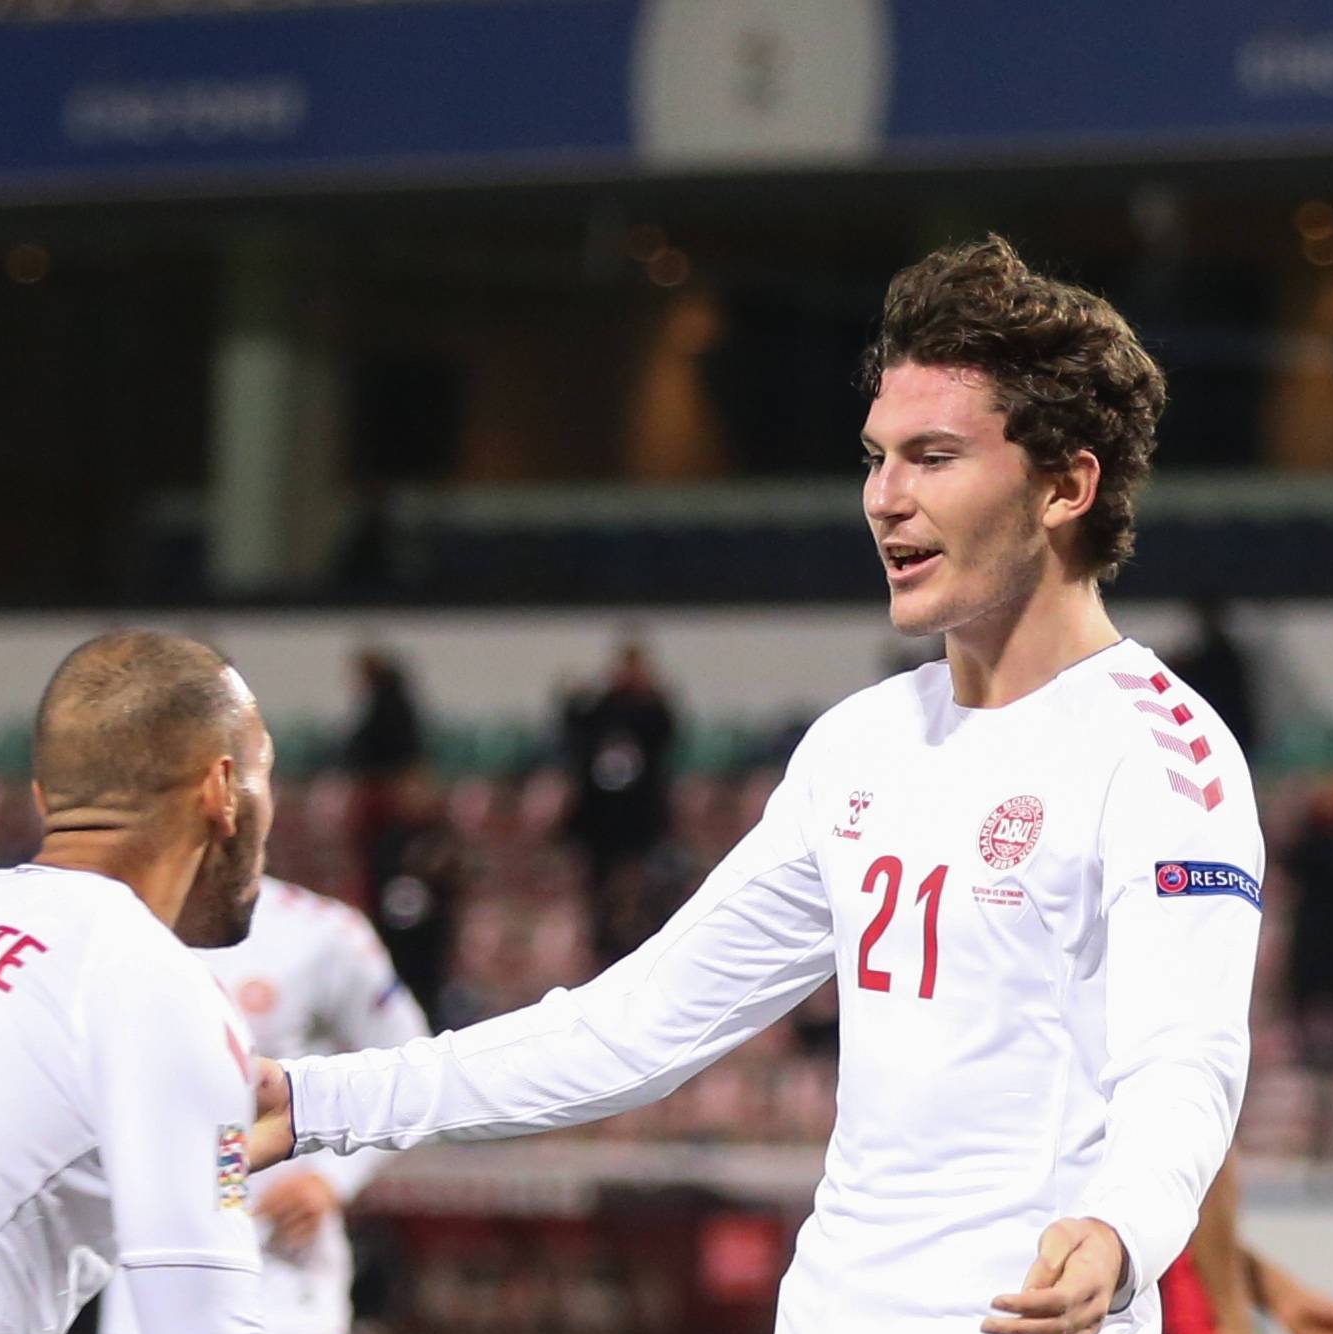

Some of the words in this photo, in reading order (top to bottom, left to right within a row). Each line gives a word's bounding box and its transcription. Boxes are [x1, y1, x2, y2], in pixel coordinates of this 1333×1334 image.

[992, 817, 1034, 843] DBU
[1190, 870, 1260, 902] RESPECT
[858, 855, 949, 999] 21
